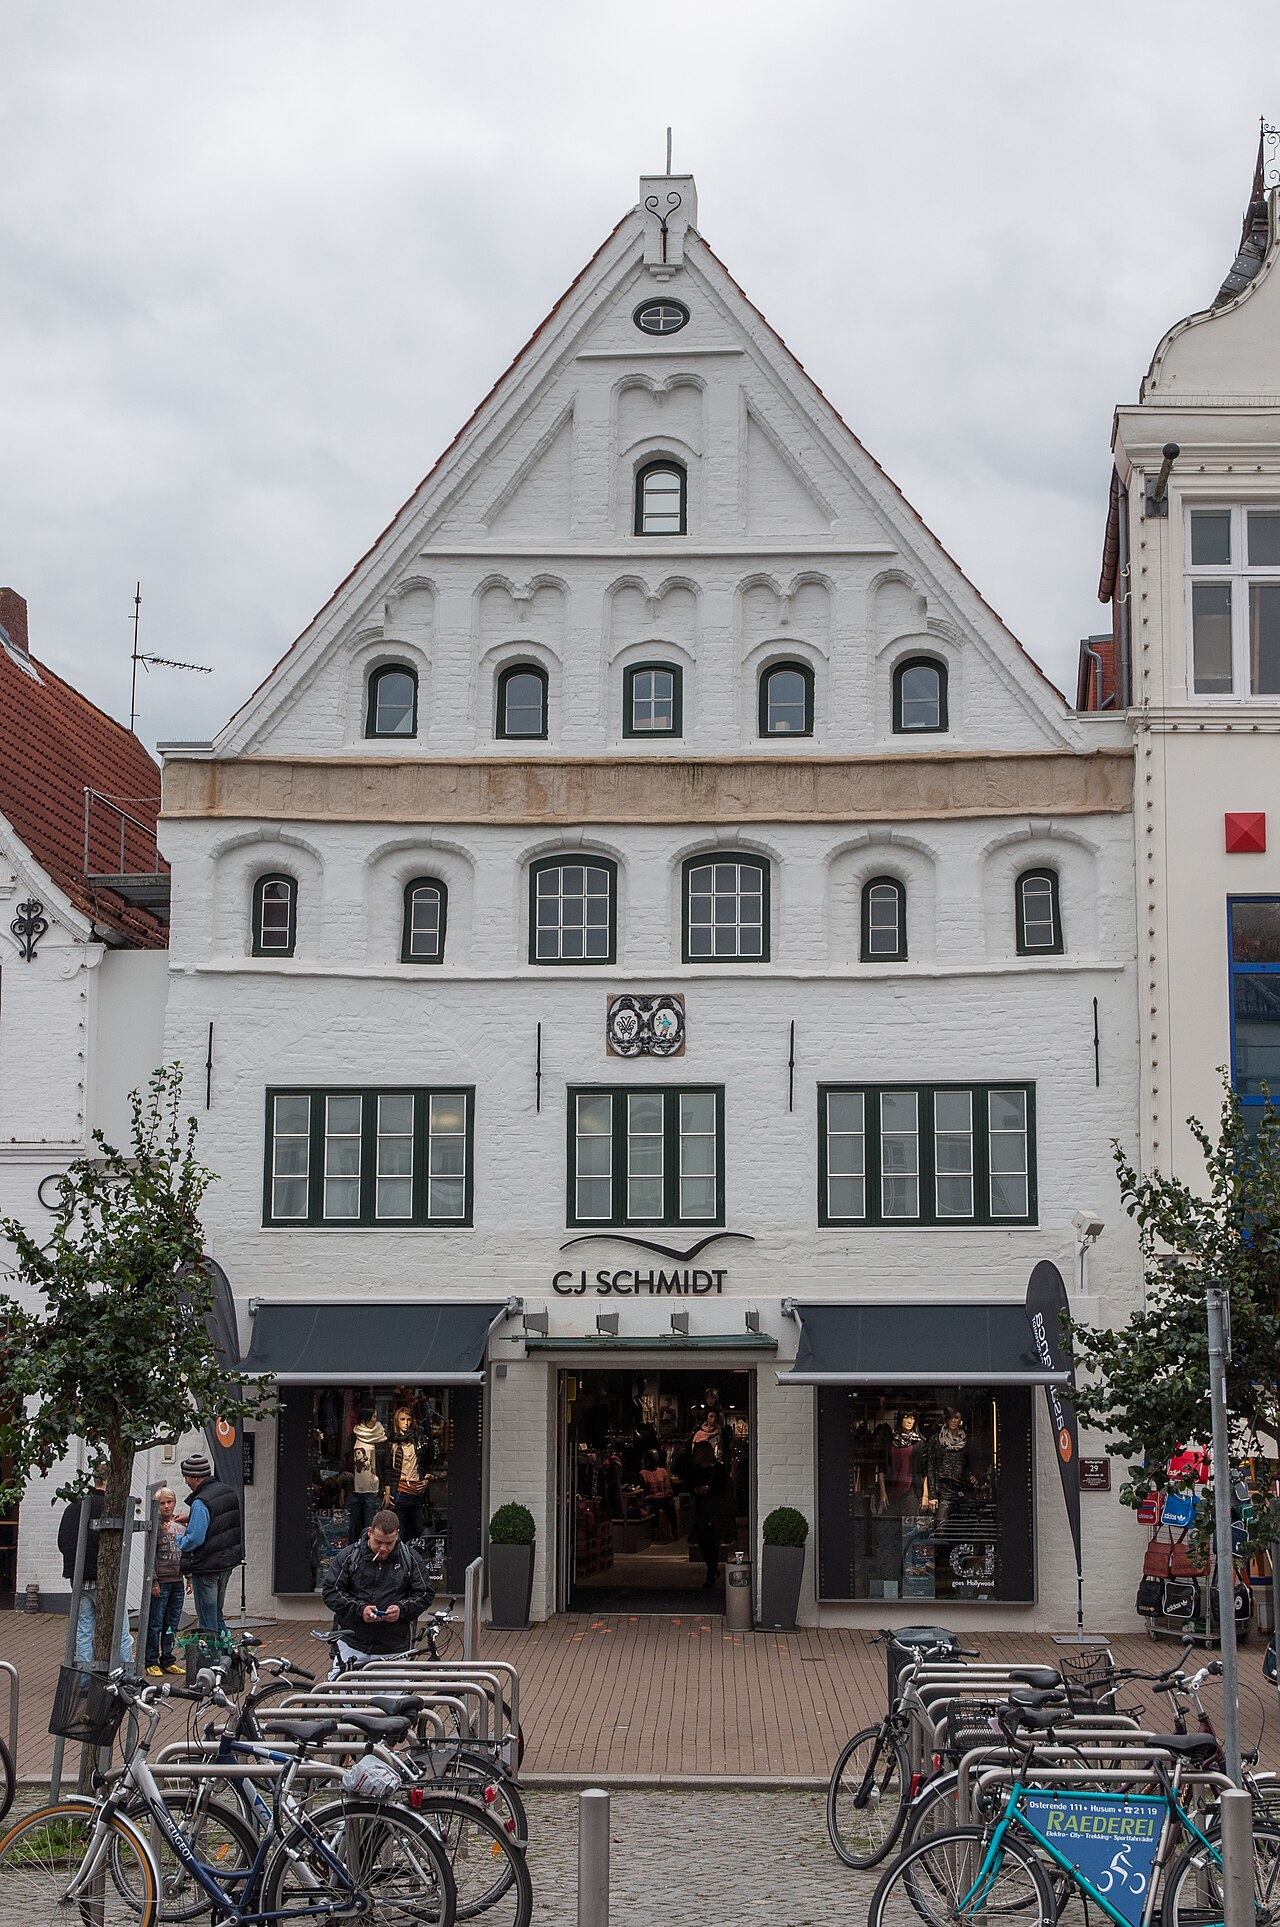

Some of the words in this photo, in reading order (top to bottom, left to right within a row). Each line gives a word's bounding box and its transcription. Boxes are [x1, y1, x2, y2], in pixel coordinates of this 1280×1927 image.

[552, 1271, 586, 1295] CJ
[596, 1270, 728, 1295] SCHMIDT
[967, 1580, 995, 1588] Hollywood
[1029, 1801, 1067, 1810] Osterende
[1090, 1805, 1116, 1813] Husum
[1047, 1811, 1154, 1836] RAEDEREI
[165, 1818, 194, 1860] PEUGEOT
[1113, 1835, 1154, 1843] Sportfahrräder
